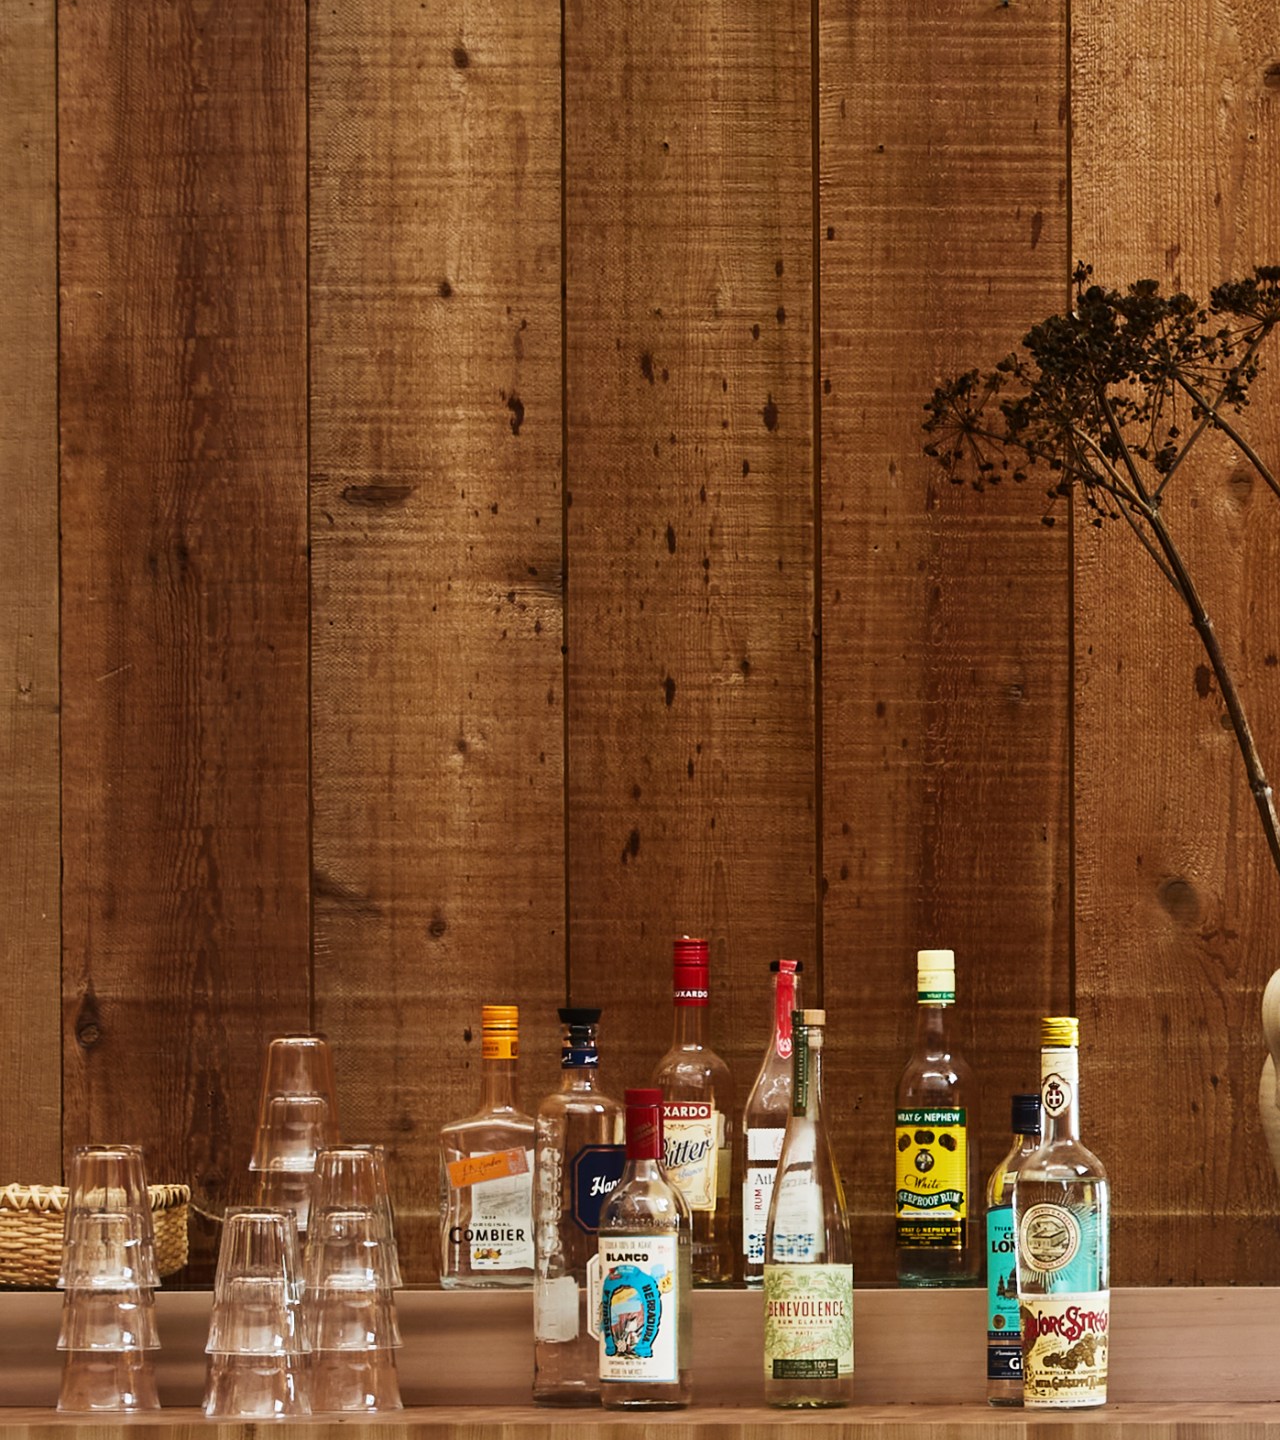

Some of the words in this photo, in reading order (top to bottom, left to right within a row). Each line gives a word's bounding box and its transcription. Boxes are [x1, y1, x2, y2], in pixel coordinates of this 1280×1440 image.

[673, 990, 708, 998] UXARDO
[663, 1105, 709, 1117] XARDO
[914, 1113, 922, 1122] &
[924, 1113, 960, 1122] NEPHEW
[904, 1174, 940, 1190] White
[940, 1192, 960, 1204] RUM
[606, 1252, 649, 1262] BLANCO
[642, 1283, 656, 1342] HERRADURA
[768, 1300, 844, 1317] BENEVOLENCE
